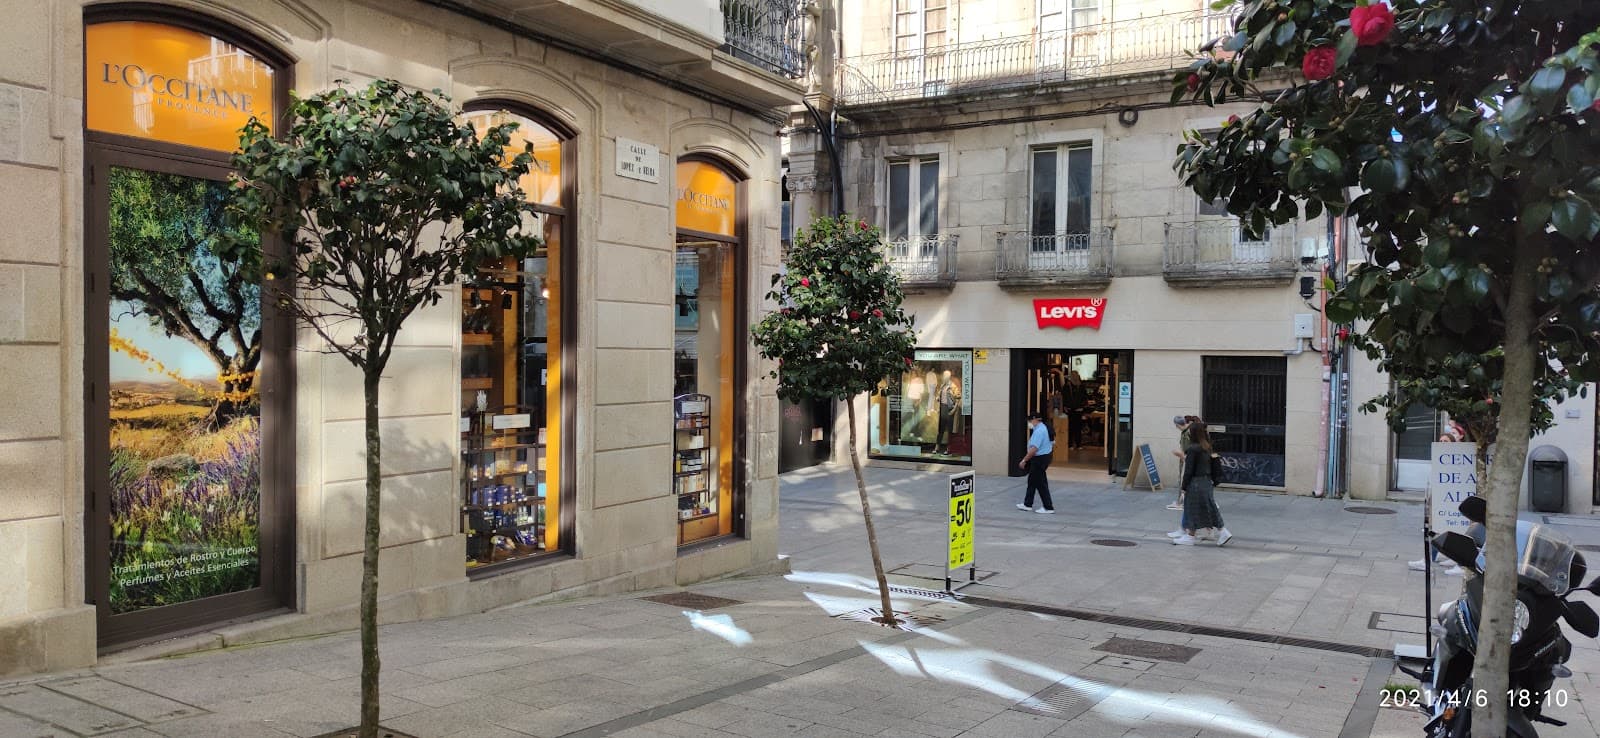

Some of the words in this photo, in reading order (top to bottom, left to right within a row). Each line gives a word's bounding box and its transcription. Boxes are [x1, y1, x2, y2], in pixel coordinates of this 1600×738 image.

[102, 62, 254, 113] L'OCCITANE
[1439, 472, 1462, 484] DE
[113, 558, 175, 575] Tratamientos
[176, 555, 189, 565] de
[190, 551, 218, 562] Rostro
[220, 550, 226, 560] y
[227, 545, 256, 557] Cuerpo
[120, 573, 165, 589] Perfumes
[166, 572, 172, 581] y
[174, 566, 206, 579] Aceites
[207, 558, 249, 573] Esenciales
